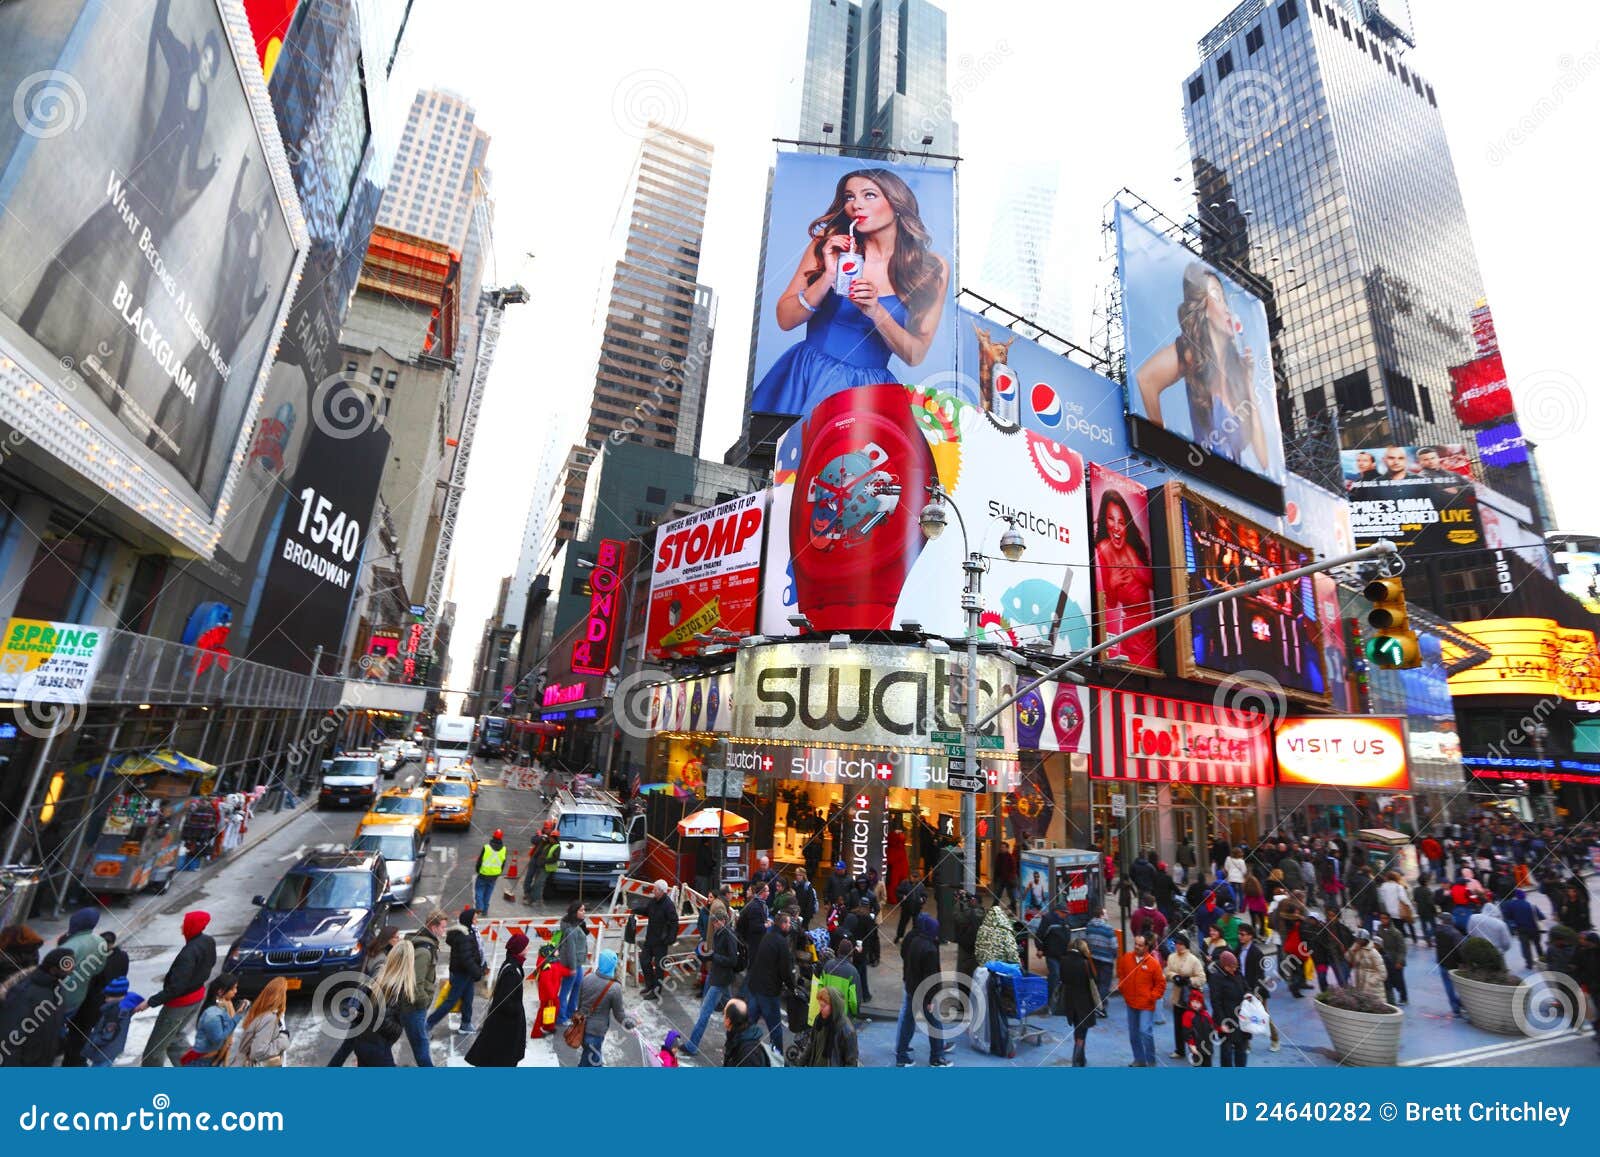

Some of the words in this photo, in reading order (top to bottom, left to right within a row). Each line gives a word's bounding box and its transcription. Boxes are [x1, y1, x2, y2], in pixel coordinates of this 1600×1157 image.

[112, 280, 198, 405] BLACKGLAMA
[1065, 414, 1114, 445] pepsi
[297, 486, 360, 563] 1540
[666, 521, 684, 533] WHERE
[685, 516, 698, 527] NEW
[699, 510, 715, 522] YORK
[716, 502, 736, 516] TURNS
[737, 499, 745, 509] IT
[746, 495, 756, 507] UP
[988, 499, 1058, 541] swatch
[1440, 508, 1474, 523] LIVE
[655, 507, 762, 574] STOMP
[283, 537, 352, 590] BROADWAY
[10, 624, 99, 648] SPRING
[1287, 737, 1342, 754] VISIT
[1353, 739, 1385, 755] US
[791, 757, 876, 779] swatch
[966, 780, 980, 788] WAY
